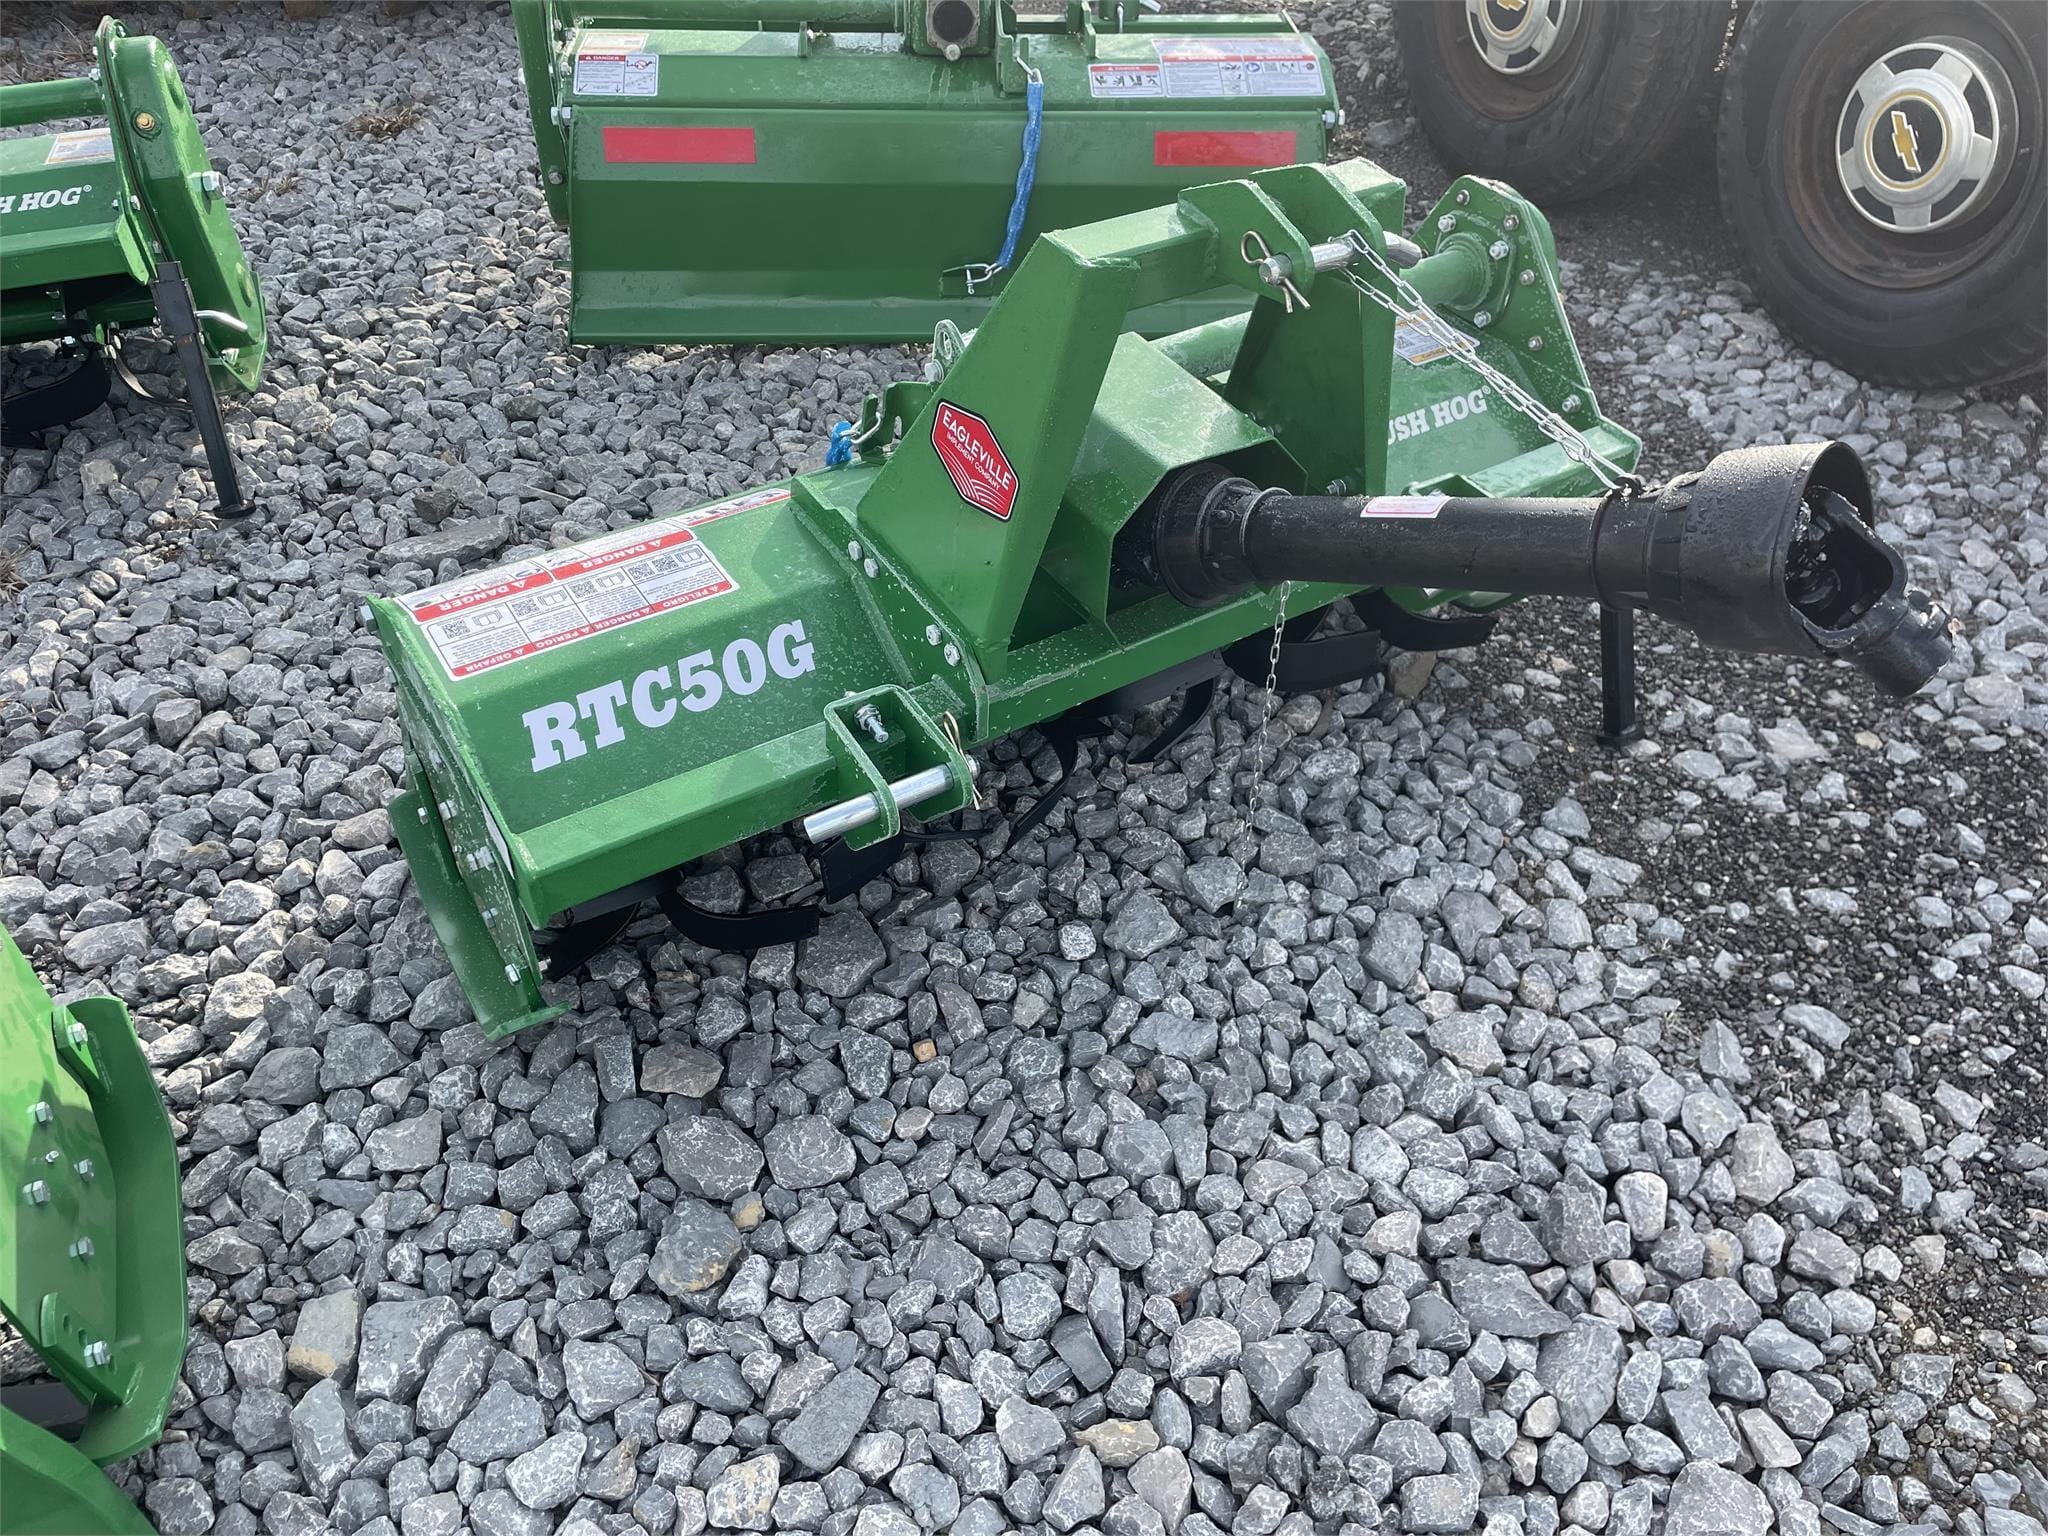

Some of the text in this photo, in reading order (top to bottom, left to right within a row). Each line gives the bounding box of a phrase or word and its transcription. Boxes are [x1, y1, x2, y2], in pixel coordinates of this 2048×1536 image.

[942, 410, 1012, 491] EAGLEVILLE
[946, 431, 1000, 491] IMPLEMENT COMPANY
[581, 545, 648, 569] DANGER
[437, 586, 510, 611] DANGER
[662, 590, 711, 608] PELIGRO
[592, 609, 641, 630] DANGER
[536, 631, 579, 649] PERIGO
[465, 652, 512, 673] GEFAHR
[521, 619, 817, 773] RTC50G
